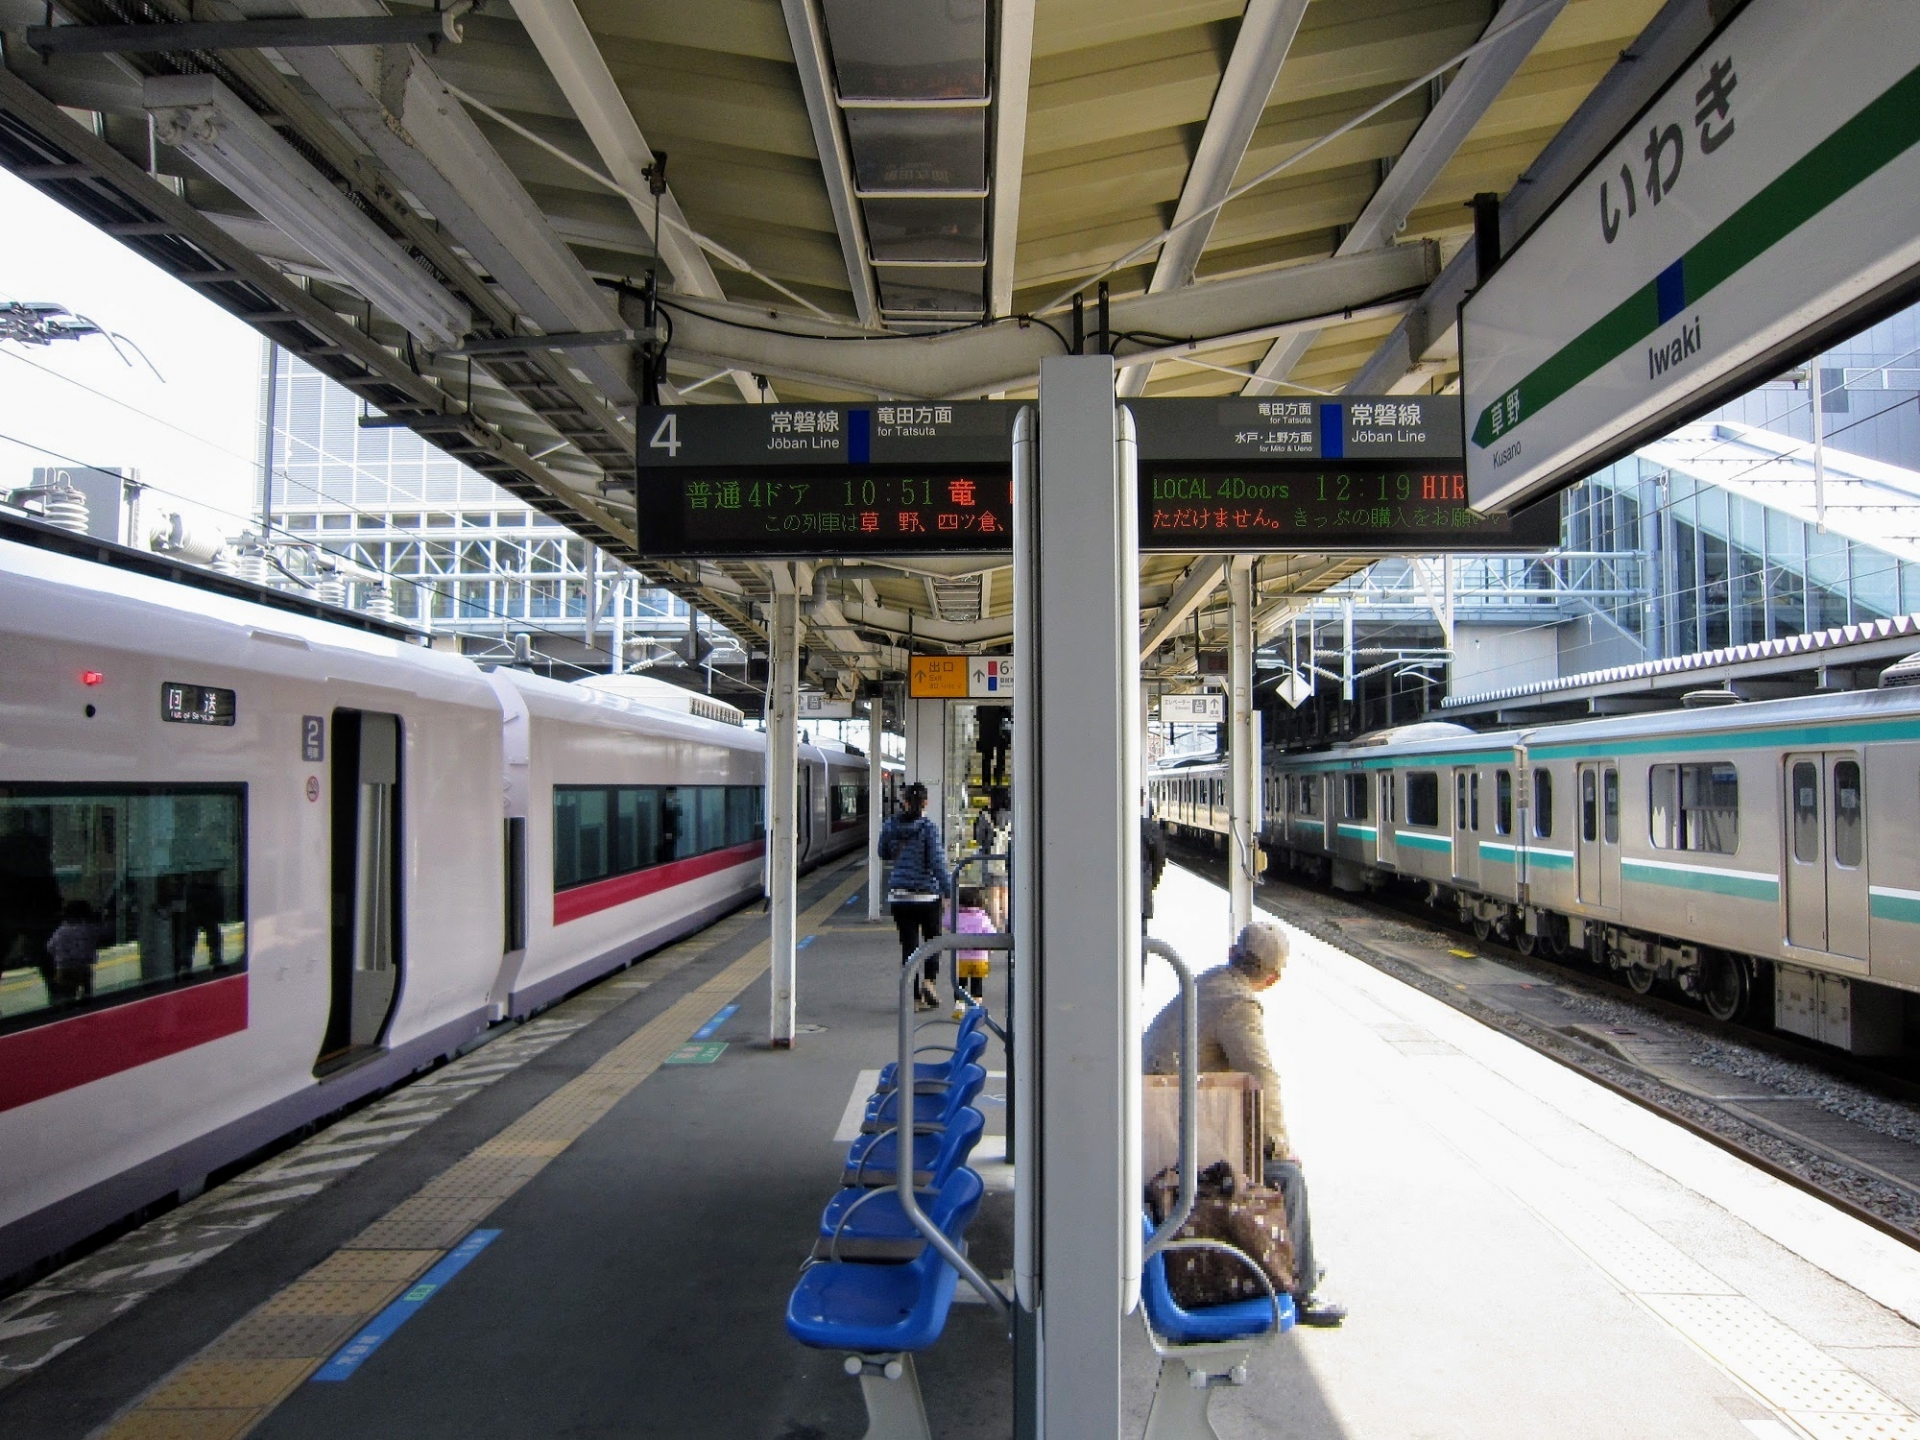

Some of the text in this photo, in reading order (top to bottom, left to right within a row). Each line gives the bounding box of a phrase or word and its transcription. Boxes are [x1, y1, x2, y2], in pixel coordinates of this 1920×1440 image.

[1600, 55, 1739, 245] いわき
[1648, 315, 1701, 380] Iwaki
[877, 406, 953, 425] 竜田方面
[1258, 402, 1312, 416] 竜田方面
[1350, 403, 1422, 426] 常磐線
[1490, 388, 1521, 436] 草野
[770, 410, 840, 434] 常磐線
[877, 426, 936, 436] for Tatsuta
[650, 413, 682, 457] 4
[767, 436, 840, 450] Jōban Line
[1351, 430, 1426, 443] Jōban Line
[1492, 440, 1522, 470] Kusano
[843, 479, 933, 506] 10:51
[1153, 478, 1212, 500] LOCAL
[1217, 477, 1290, 499] 4Doors
[1316, 474, 1411, 501] 12:19
[929, 660, 954, 673] 出口
[308, 720, 319, 746] 2
